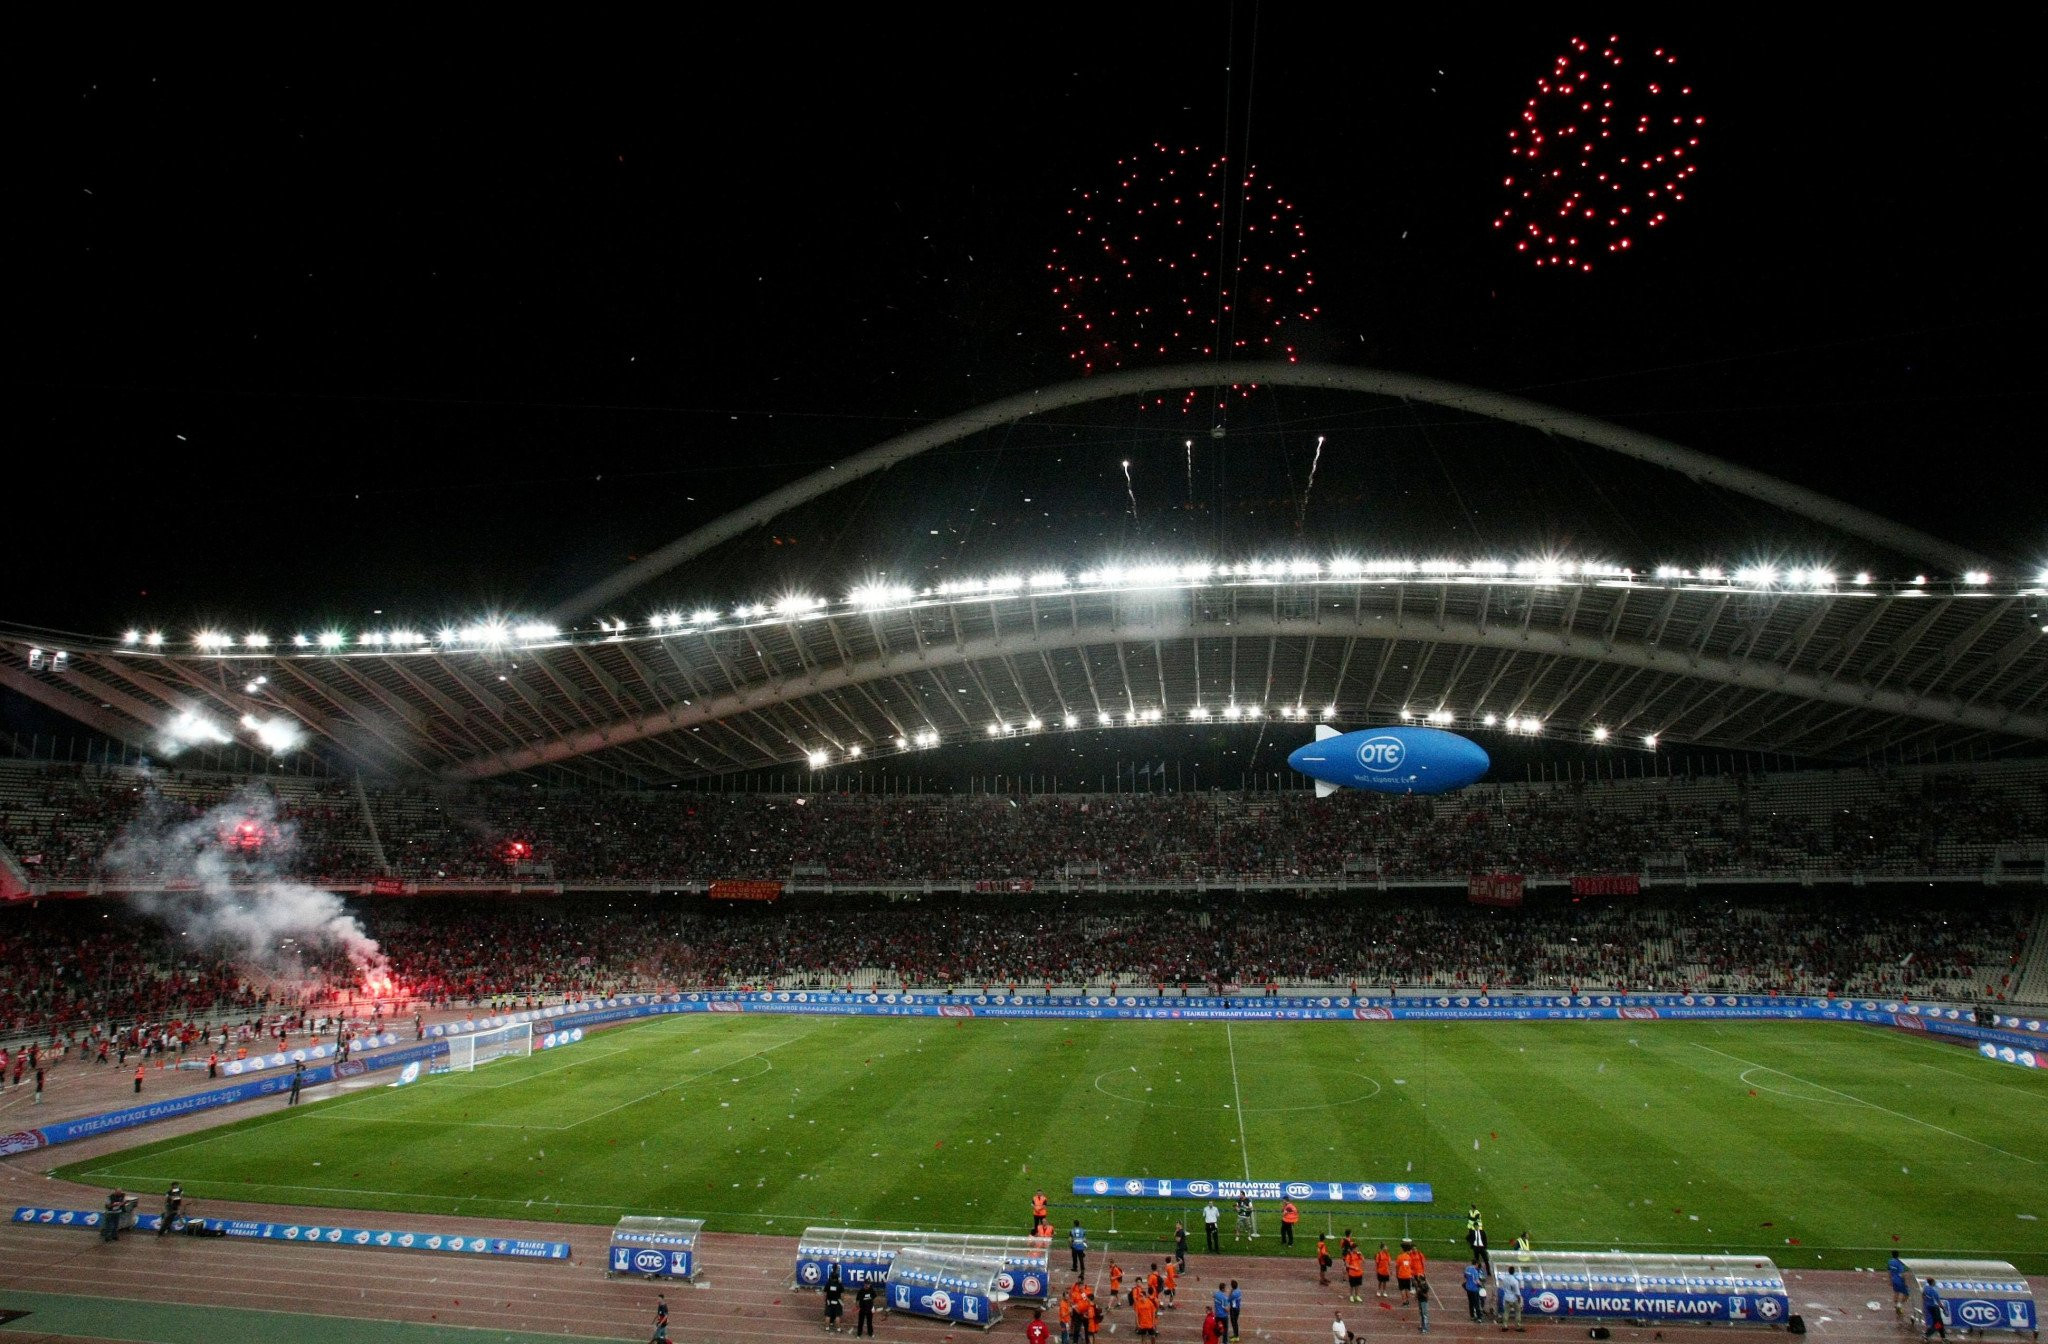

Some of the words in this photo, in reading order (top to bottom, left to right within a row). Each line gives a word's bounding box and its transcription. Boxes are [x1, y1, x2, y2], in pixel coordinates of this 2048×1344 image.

[1360, 744, 1400, 763] OTE
[68, 1111, 147, 1135] ΚΥΠΕΛΛΟΥΧΟΣ
[150, 1102, 194, 1117] ΕΛΛΑΔΑΣ
[196, 1089, 242, 1106] 2014-2015
[1190, 1184, 1211, 1192] OTE
[1288, 1186, 1310, 1194] OTE
[1218, 1189, 1258, 1198] ΕΛΛΑΑΣ
[1260, 1190, 1280, 1198] 2015
[516, 1241, 545, 1249] ΤΕΛΙΚΟΣ
[511, 1248, 547, 1257] ΚΥΠΕΛΛΟΥ
[637, 1255, 662, 1267] OTE
[1566, 1296, 1631, 1312] ΤΕΛΙΚΟΣ
[1635, 1298, 1718, 1314] ΚΥΠΕΛΛΟΥ
[1962, 1306, 1996, 1321] OTE
